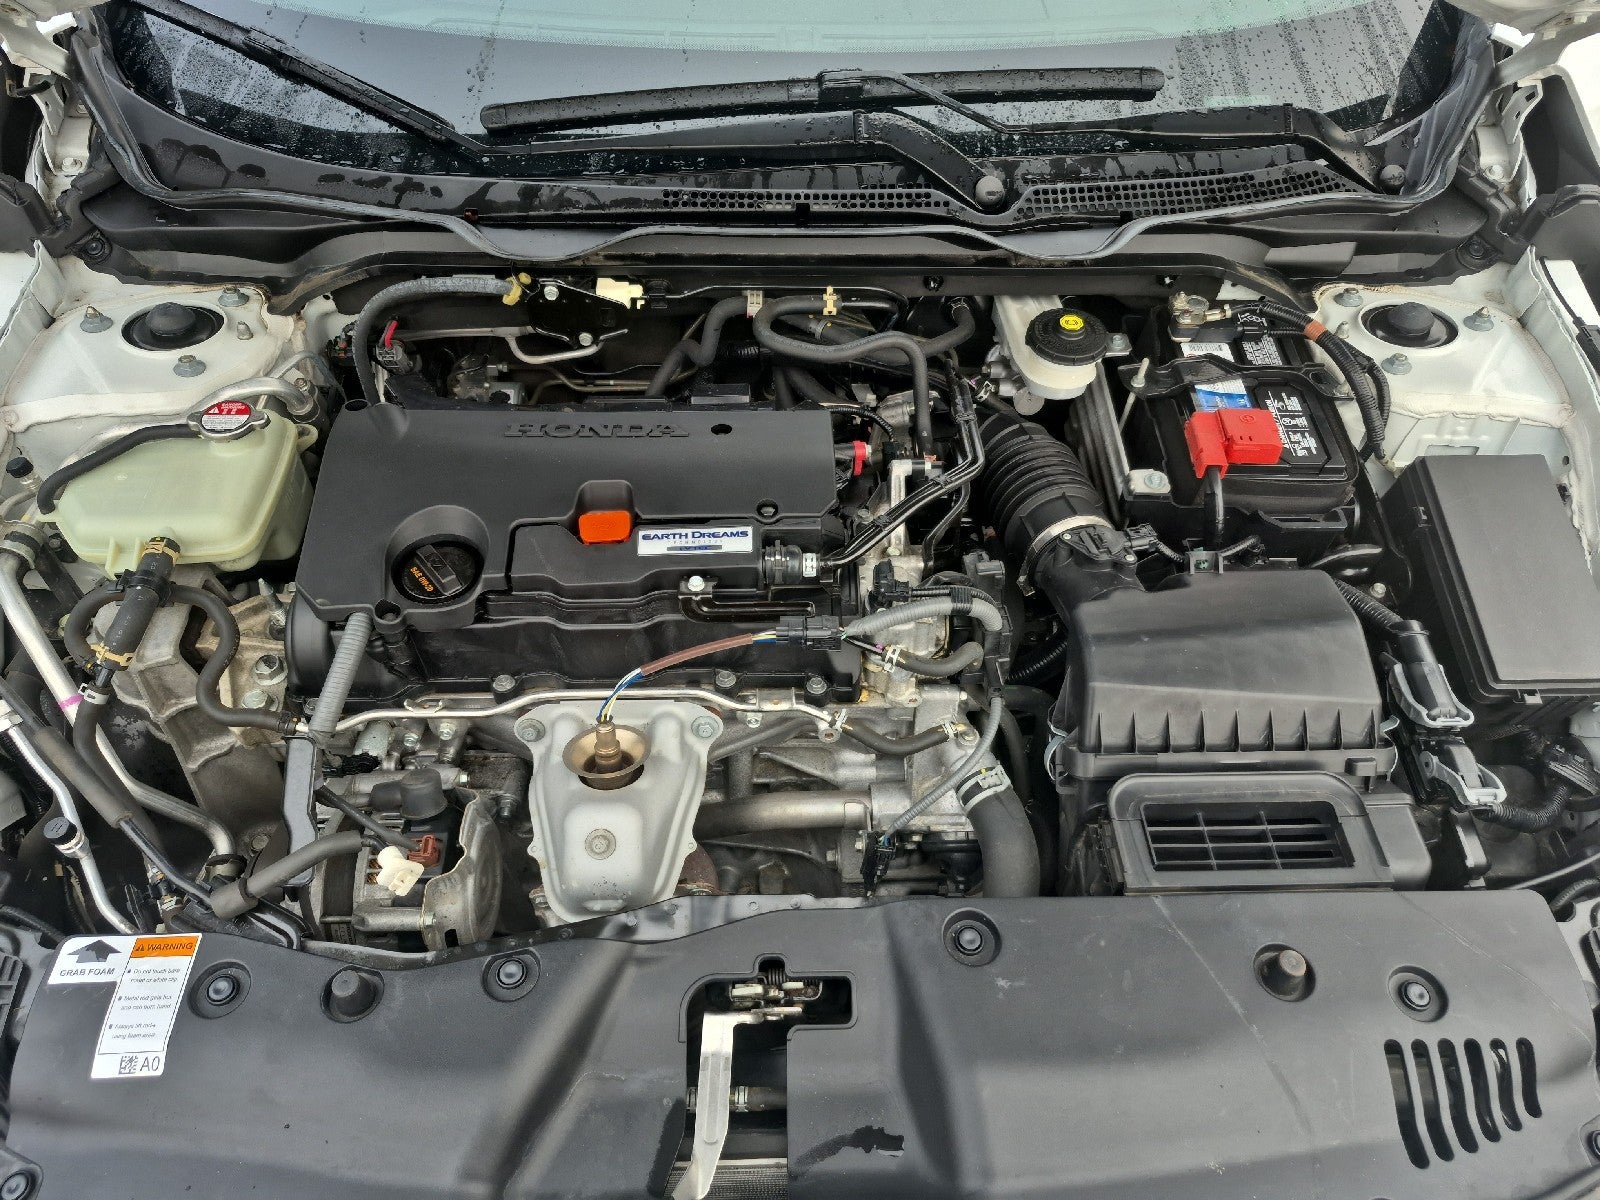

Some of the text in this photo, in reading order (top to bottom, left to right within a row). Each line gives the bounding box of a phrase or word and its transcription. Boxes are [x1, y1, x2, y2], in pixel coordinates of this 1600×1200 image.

[504, 424, 690, 437] HONDA
[642, 531, 749, 540] EARTH DREAMS
[147, 941, 194, 951] WARNING
[60, 967, 115, 977] GRAB FOAM
[139, 1056, 160, 1072] A0
